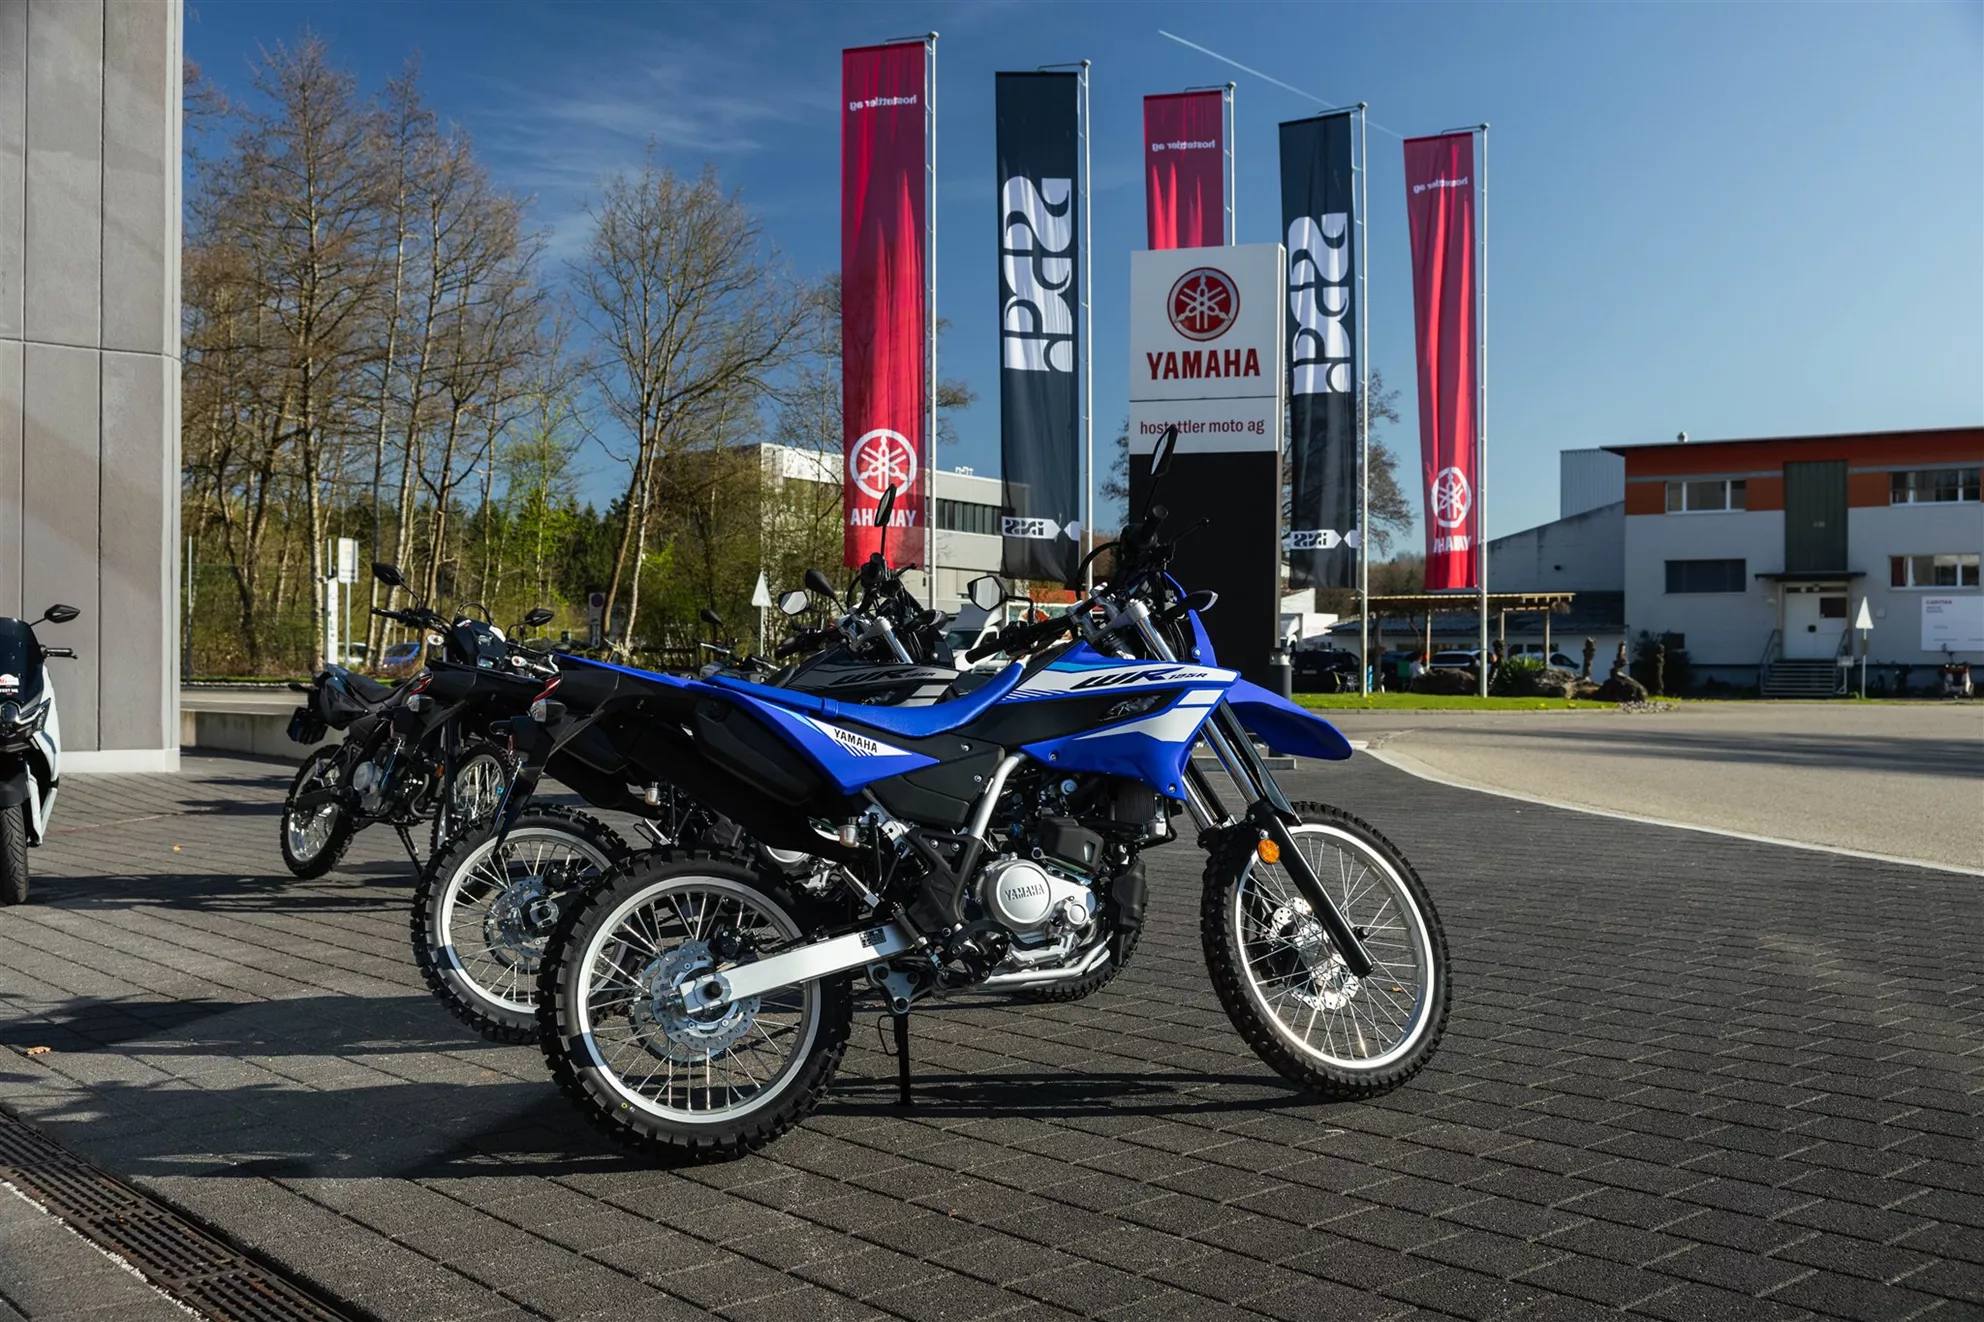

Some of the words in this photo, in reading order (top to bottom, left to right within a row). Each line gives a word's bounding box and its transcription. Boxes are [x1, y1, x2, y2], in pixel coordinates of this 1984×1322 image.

[1146, 348, 1260, 380] YAMAHA
[1140, 420, 1206, 435] hostttler
[1209, 419, 1243, 433] moto
[1247, 419, 1265, 435] ag
[834, 728, 878, 753] YAMAHA
[1004, 884, 1045, 901] YAMAHA
